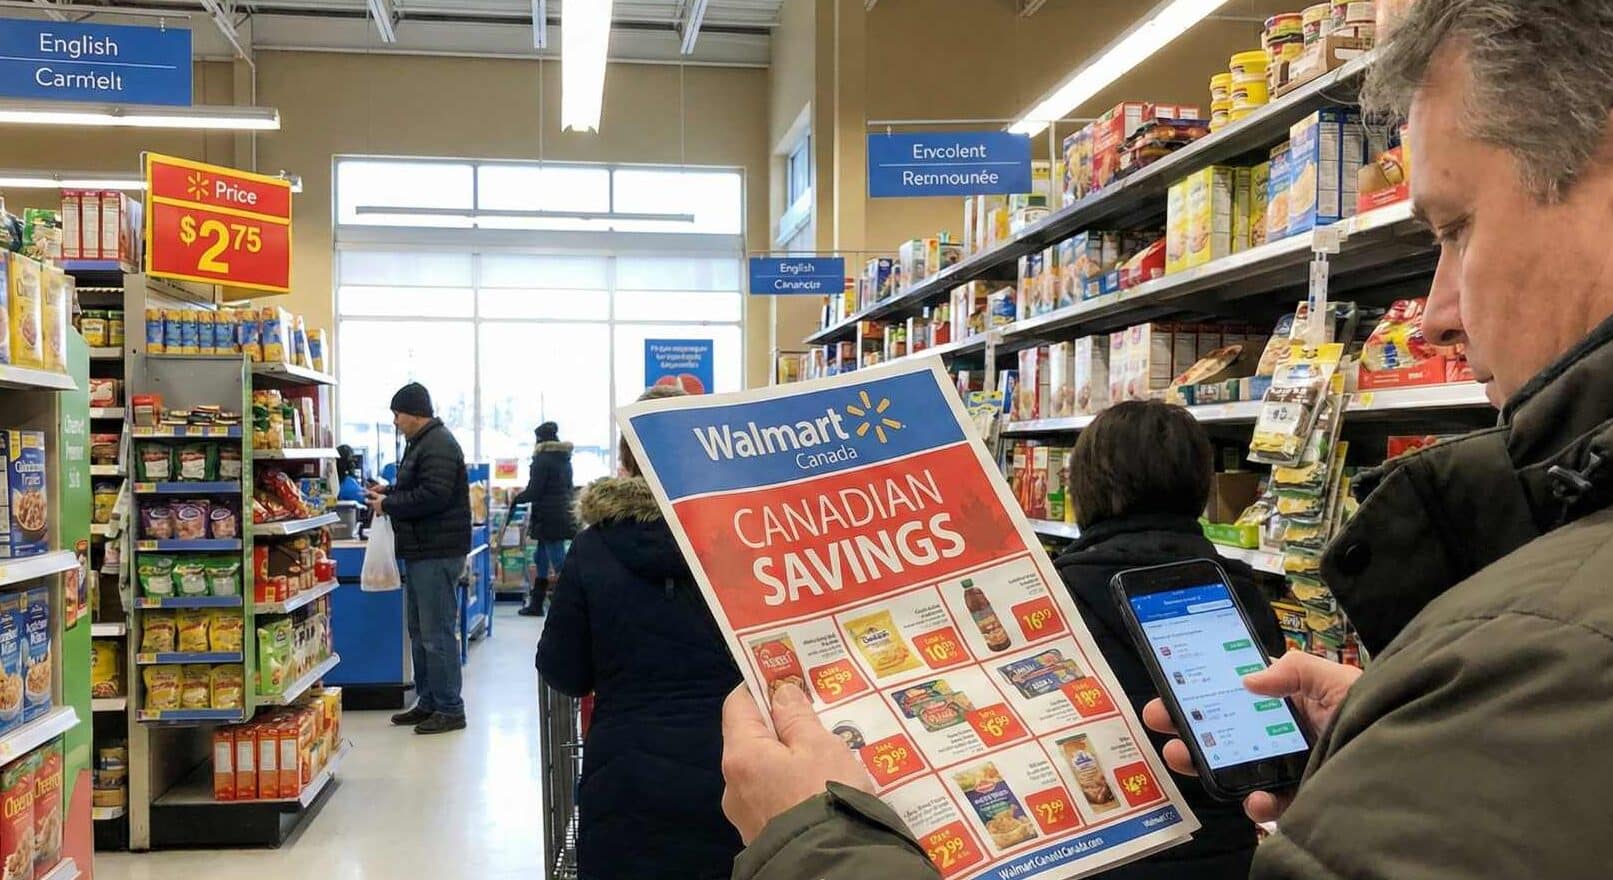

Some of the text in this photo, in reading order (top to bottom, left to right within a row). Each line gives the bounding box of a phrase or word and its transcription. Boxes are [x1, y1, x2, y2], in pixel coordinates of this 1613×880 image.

[40, 33, 118, 58] English
[215, 180, 257, 205] Price
[780, 263, 815, 275] English
[693, 408, 850, 461] Walmart
[795, 444, 858, 470] Canada
[733, 469, 944, 549] CANADIAN
[753, 512, 966, 606] SAVINGS
